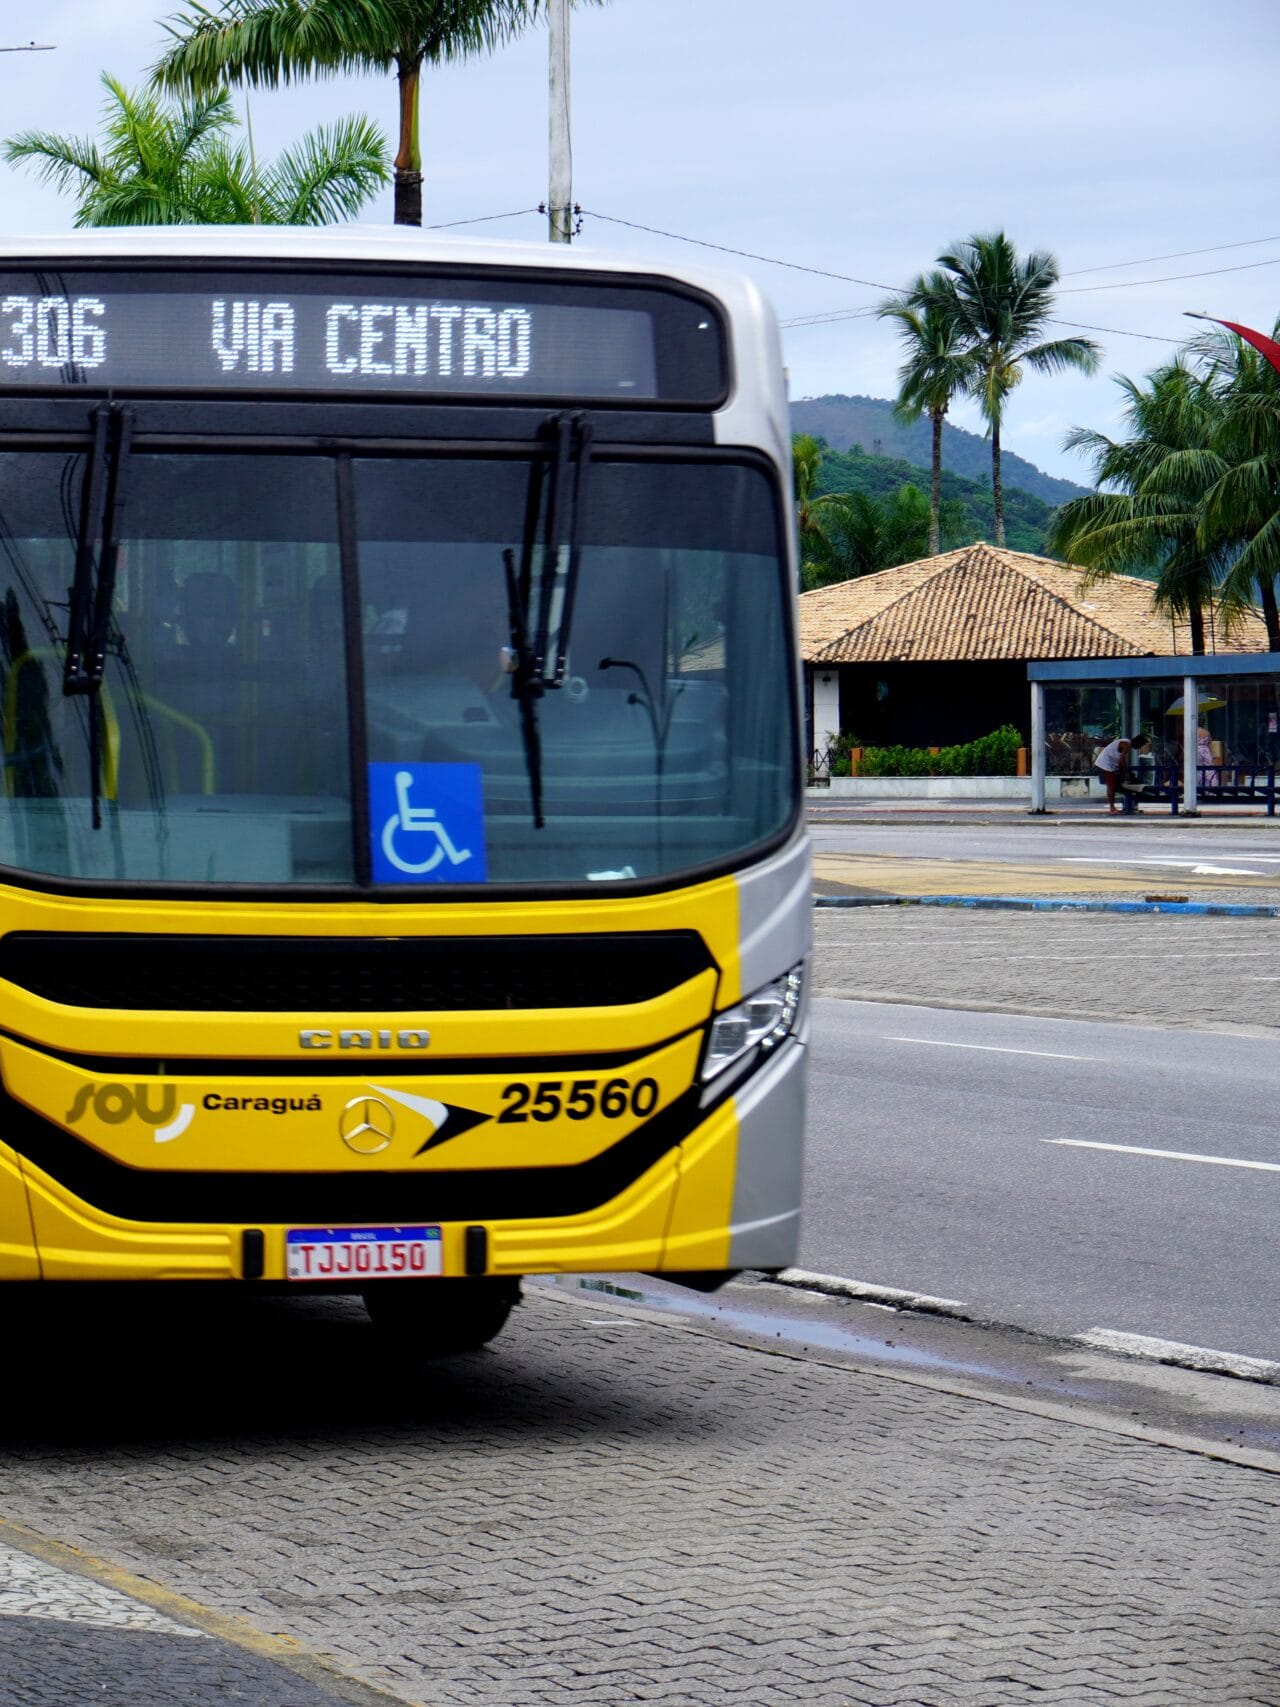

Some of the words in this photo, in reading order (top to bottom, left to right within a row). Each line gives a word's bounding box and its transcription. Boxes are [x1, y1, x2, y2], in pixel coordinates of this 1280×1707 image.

[1, 297, 107, 369] 306
[212, 300, 296, 373] VIA
[326, 304, 534, 378] CENTRO
[298, 1029, 431, 1049] CAIO
[201, 1092, 322, 1113] Caraguá
[496, 1077, 659, 1124] 25560
